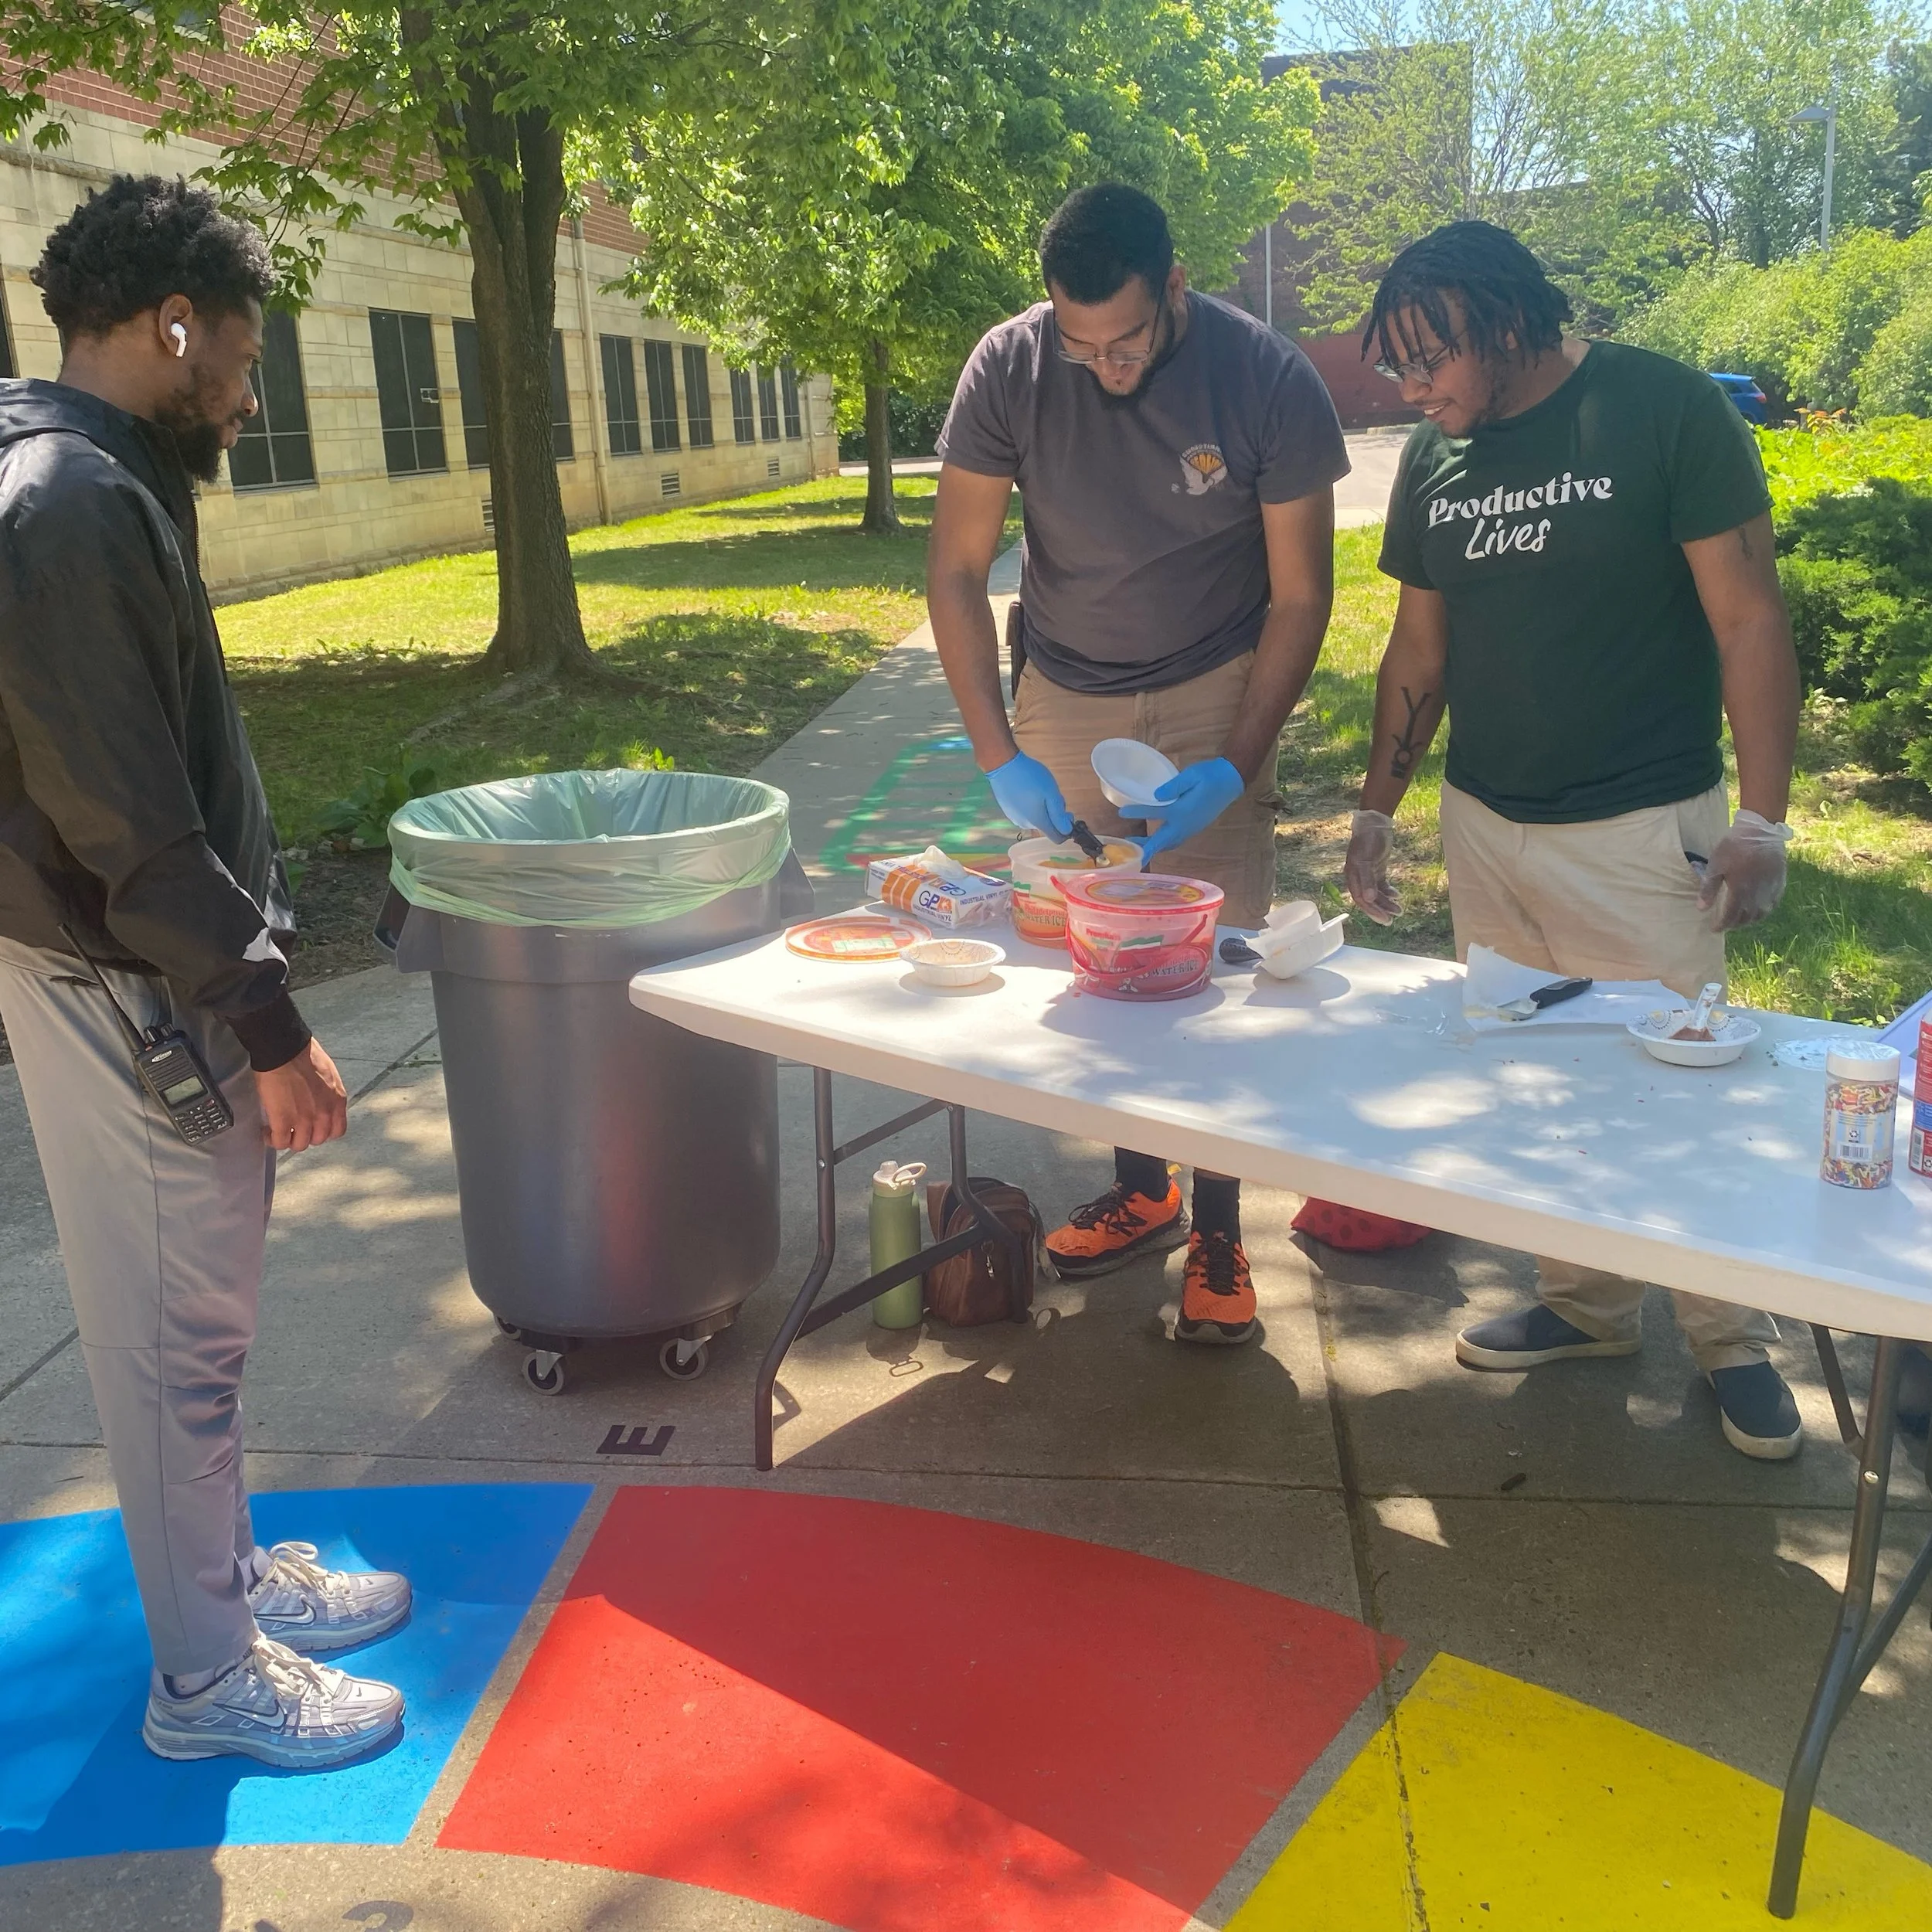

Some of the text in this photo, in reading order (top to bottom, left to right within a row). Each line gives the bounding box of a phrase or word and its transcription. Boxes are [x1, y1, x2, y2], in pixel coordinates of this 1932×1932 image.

[1427, 471, 1614, 528] Productive
[1464, 519, 1552, 560] Lives
[960, 895, 985, 906] INDUSTRIAL
[912, 903, 952, 922] INDUSTRIAL VINYL
[1026, 914, 1066, 927] WATER ICE
[1085, 927, 1121, 940] Premium
[1151, 964, 1185, 978] WATER
[596, 1424, 676, 1456] E
